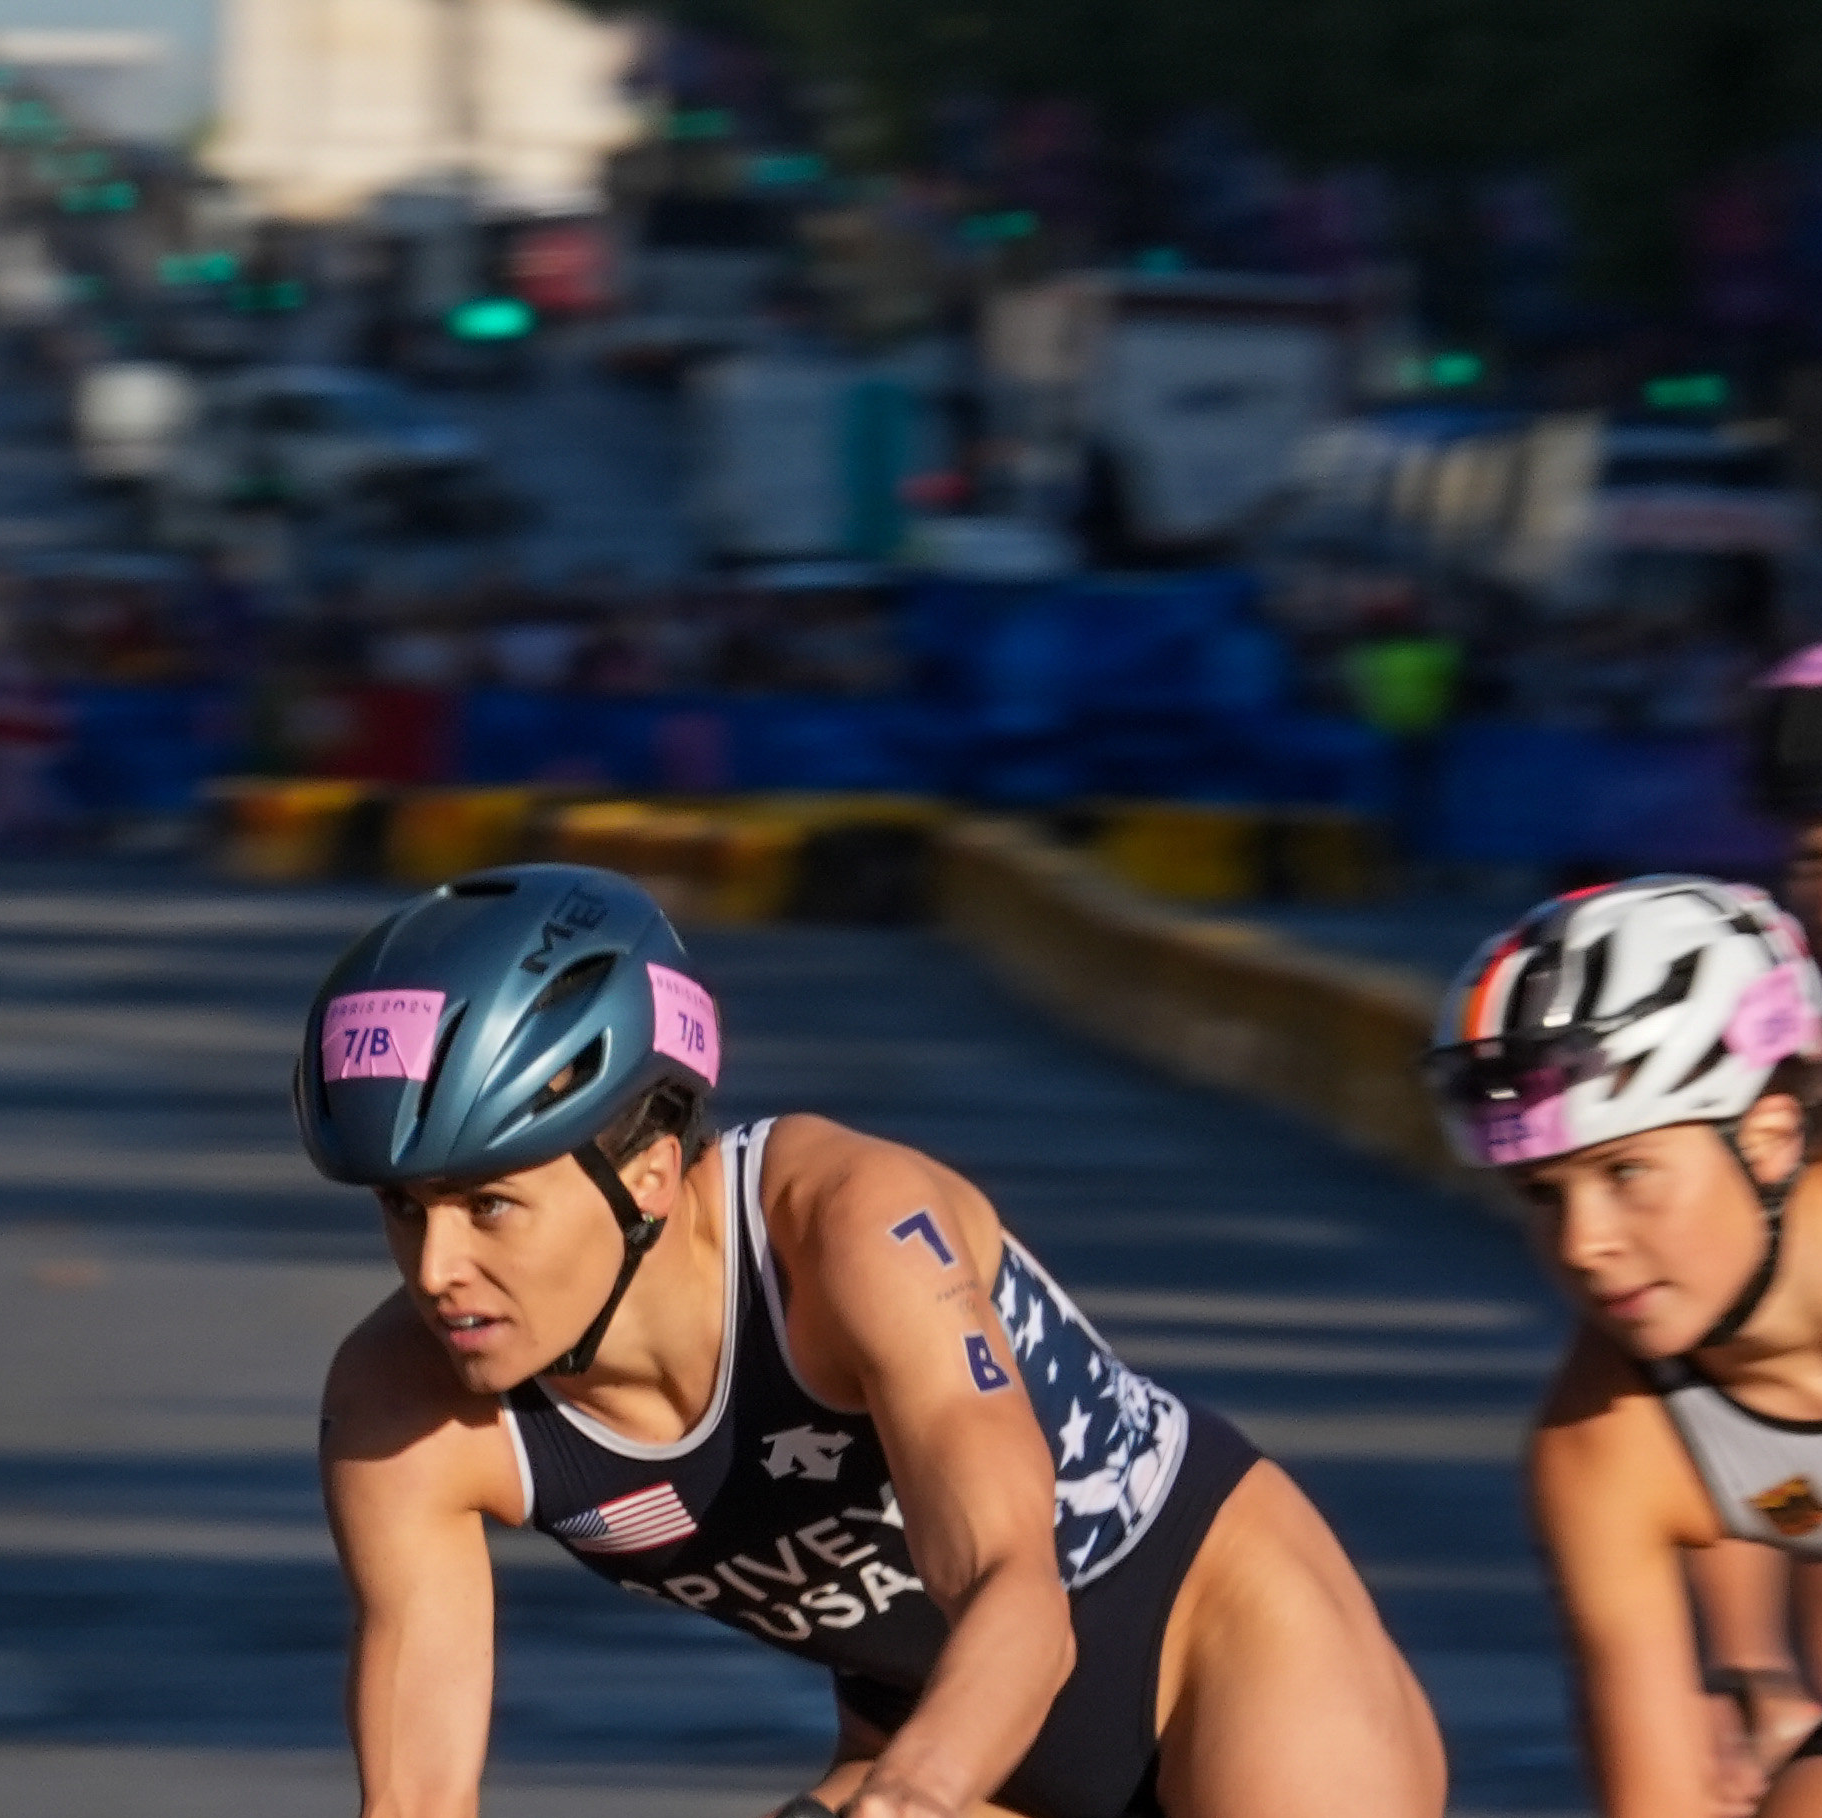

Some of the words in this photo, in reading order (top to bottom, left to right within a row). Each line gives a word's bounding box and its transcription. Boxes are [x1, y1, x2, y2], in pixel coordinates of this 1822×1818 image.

[344, 1026, 391, 1065] 7/B
[678, 1011, 705, 1053] 7/B
[887, 1208, 959, 1270] 7
[963, 1332, 1012, 1394] B
[739, 1560, 924, 1641] USA
